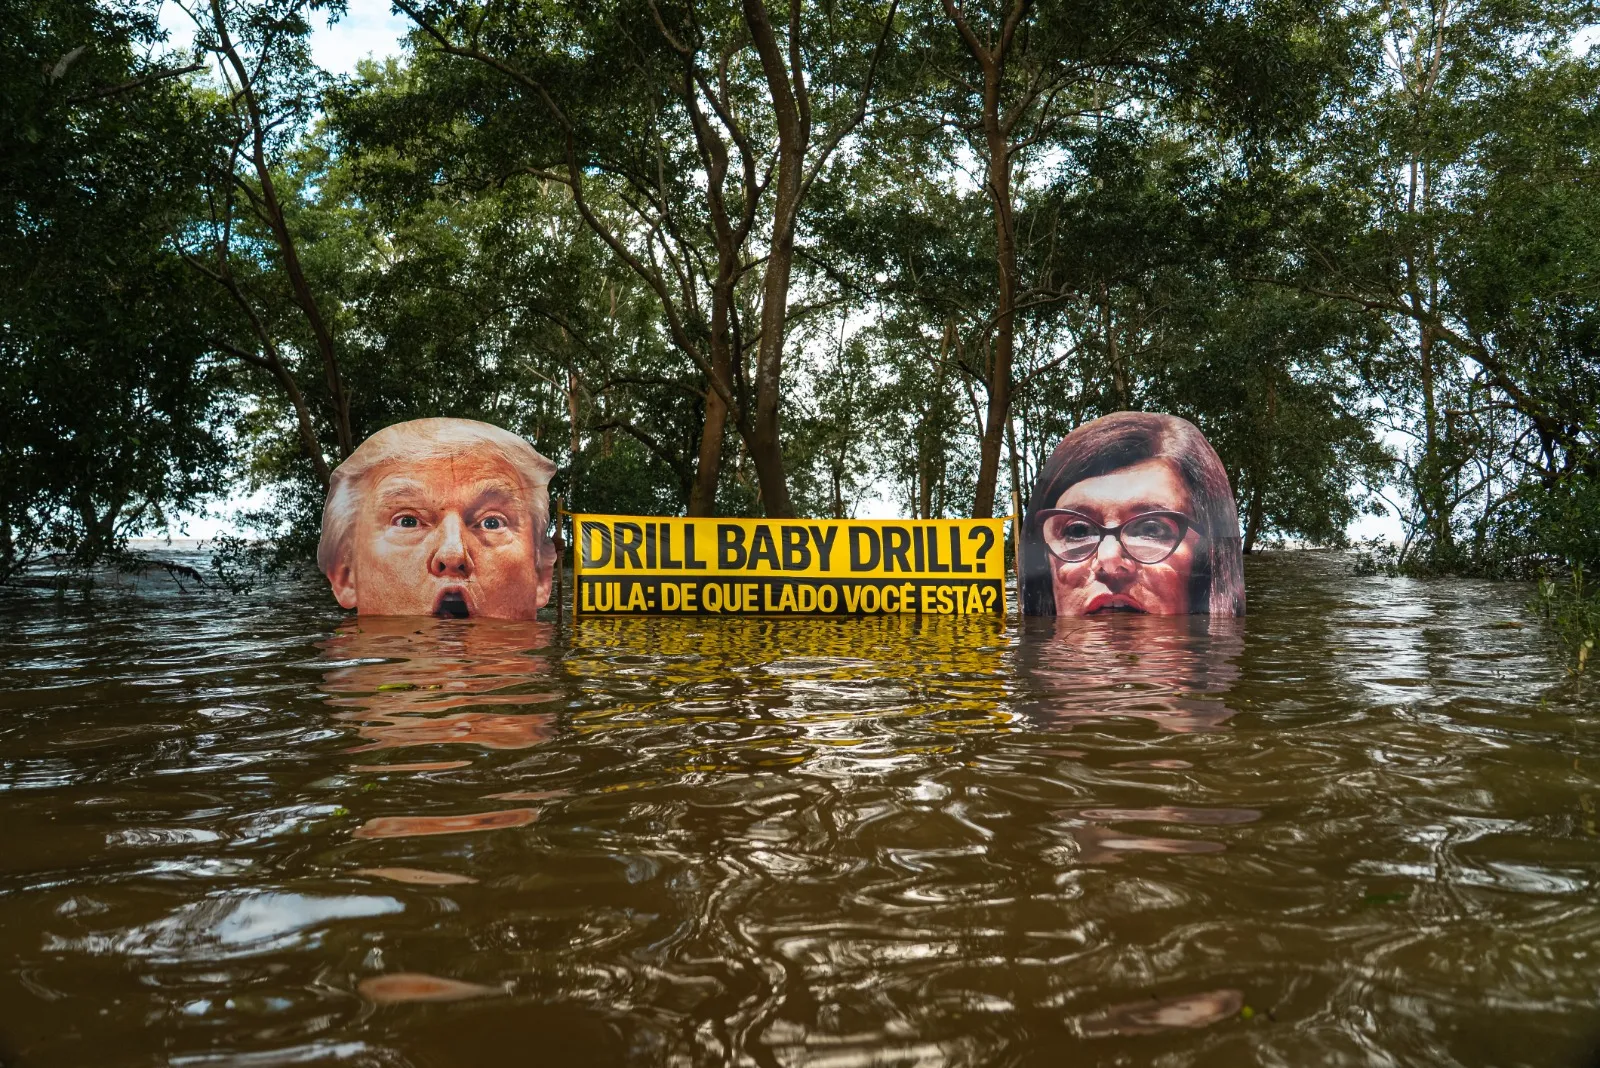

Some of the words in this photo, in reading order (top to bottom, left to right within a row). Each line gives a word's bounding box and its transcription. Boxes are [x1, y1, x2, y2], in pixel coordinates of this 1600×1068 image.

[581, 521, 706, 569] DRILL
[717, 524, 838, 571] BABY
[848, 525, 995, 573] DRILL?
[581, 582, 655, 611] LULA:
[661, 582, 698, 612] DE
[702, 583, 759, 614] QUE
[764, 583, 838, 613] LADO
[842, 582, 916, 614] VOCÊ
[921, 583, 997, 614] ESTÁ?
